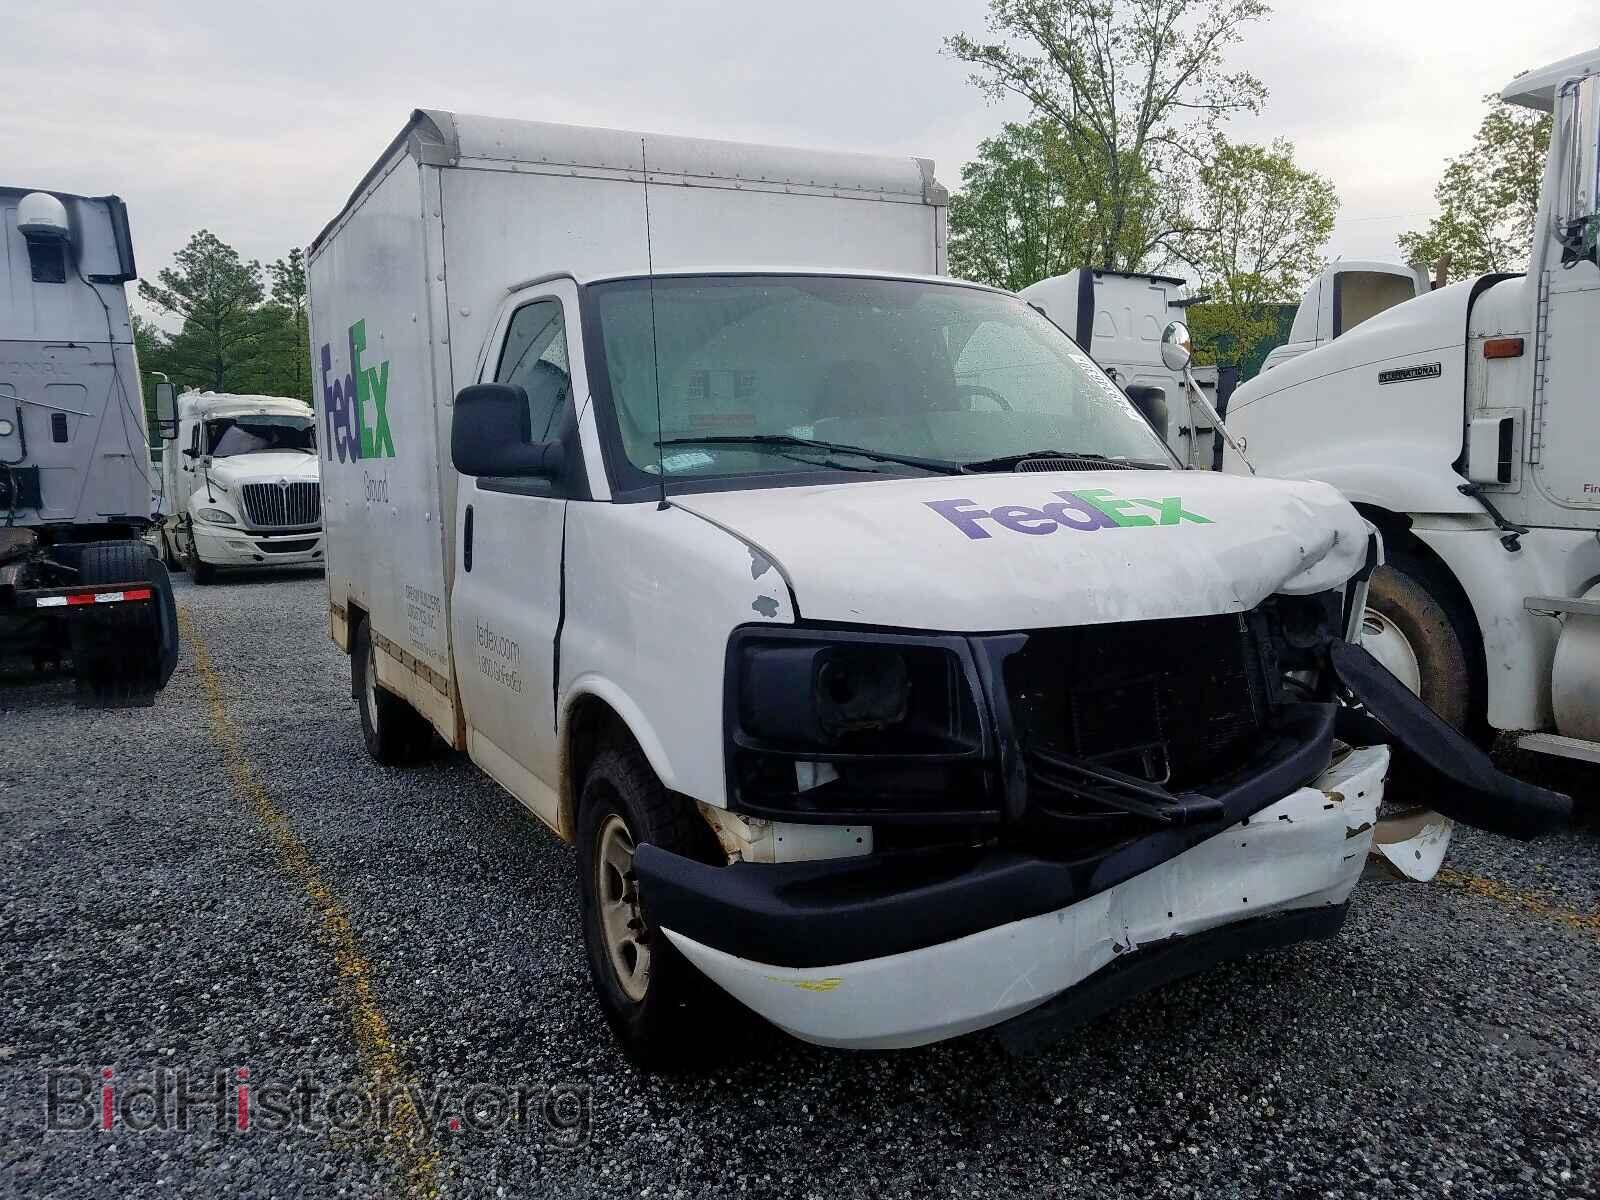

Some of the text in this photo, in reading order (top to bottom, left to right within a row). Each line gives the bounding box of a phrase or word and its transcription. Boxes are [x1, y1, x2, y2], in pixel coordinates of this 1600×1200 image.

[1379, 364, 1440, 382] INTERNATIONAL
[321, 318, 396, 464] FedEx
[1584, 483, 1600, 494] Fir
[920, 488, 1216, 539] FedEx
